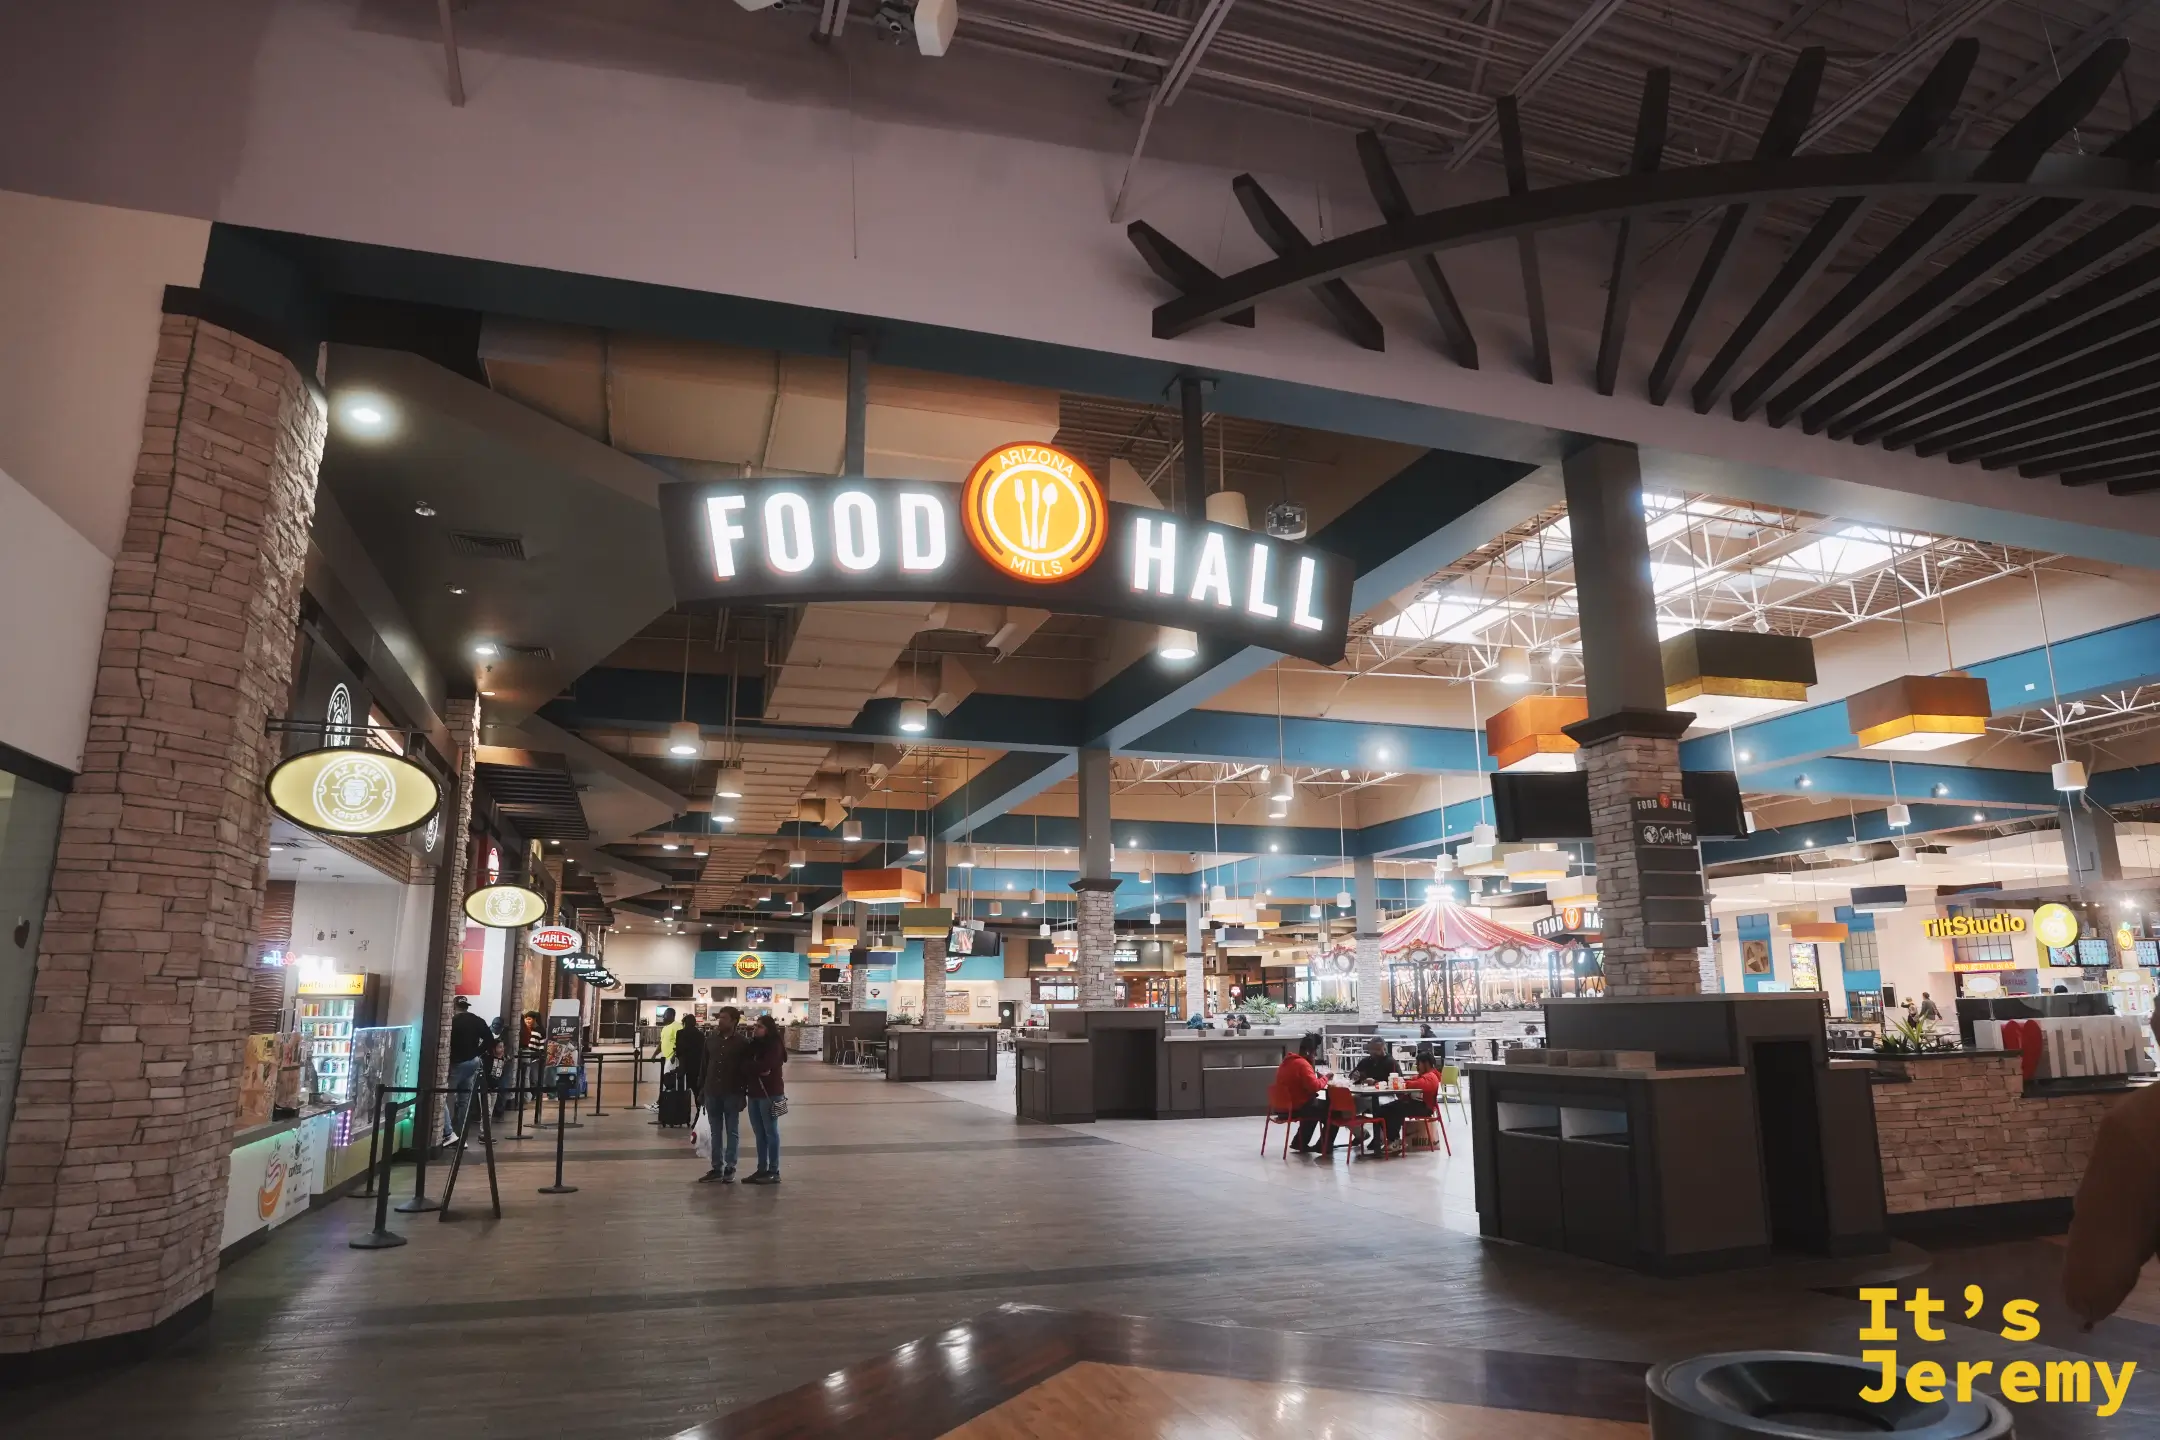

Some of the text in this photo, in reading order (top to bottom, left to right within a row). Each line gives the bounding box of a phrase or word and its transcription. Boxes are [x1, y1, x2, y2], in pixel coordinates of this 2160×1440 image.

[1000, 448, 1074, 478] ARIZONA
[706, 491, 1323, 631] FOOD HALL
[1010, 556, 1063, 577] MILLS
[334, 765, 350, 780] AZ
[332, 807, 368, 821] COFFEE
[1637, 799, 1692, 813] FOOD HALL
[1536, 912, 1604, 937] FOOD HA
[1921, 914, 2026, 938] TiltStudio
[530, 934, 578, 947] CHARLEYS
[2040, 1015, 2156, 1079] TEMPE
